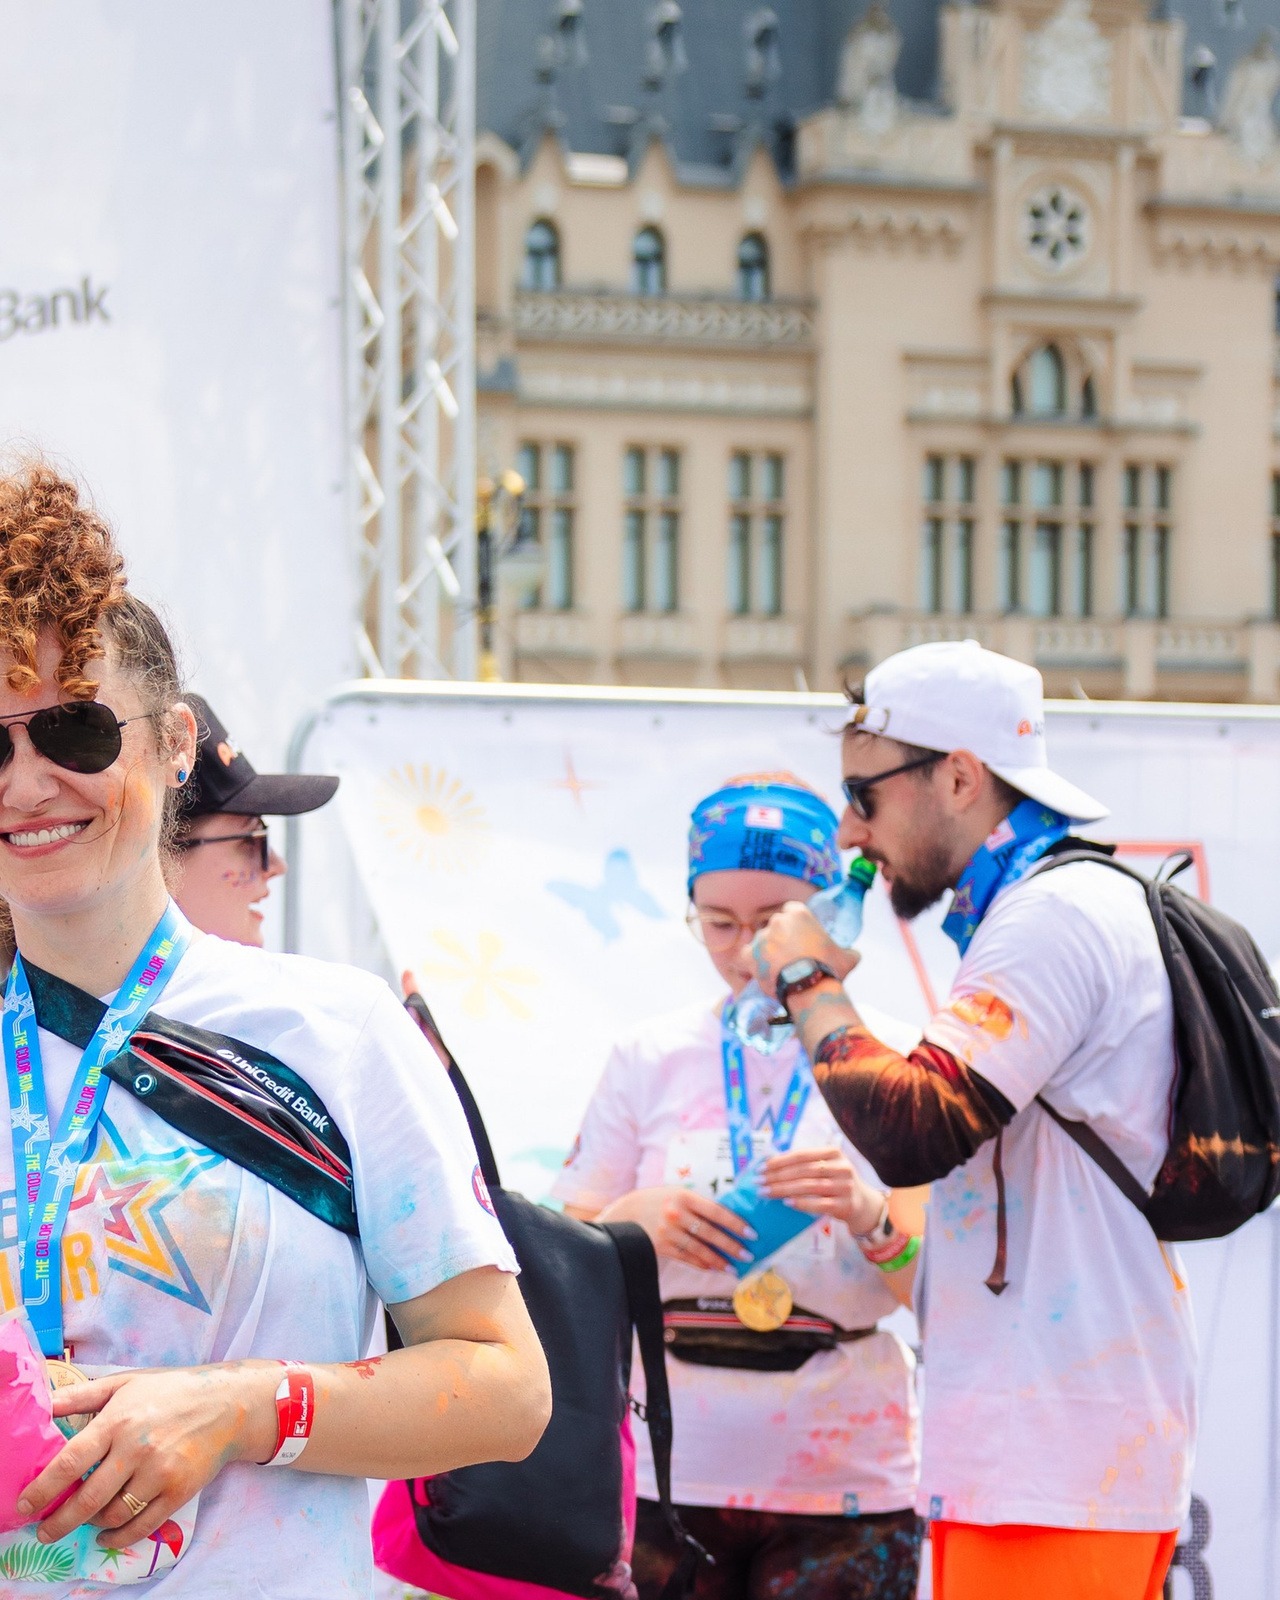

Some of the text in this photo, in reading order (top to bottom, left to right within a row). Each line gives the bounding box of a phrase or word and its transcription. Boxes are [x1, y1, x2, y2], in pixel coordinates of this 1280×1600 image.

[128, 938, 175, 1001] THE COLOR RUN
[14, 1029, 34, 1093] THE COLOR RUN
[68, 1065, 102, 1132] THE COLOR RUN
[232, 1056, 330, 1134] UniCredit Bank
[25, 1152, 40, 1172] THE
[35, 1201, 60, 1281] THE COLOR RUN
[300, 1386, 308, 1421] Kaufland
